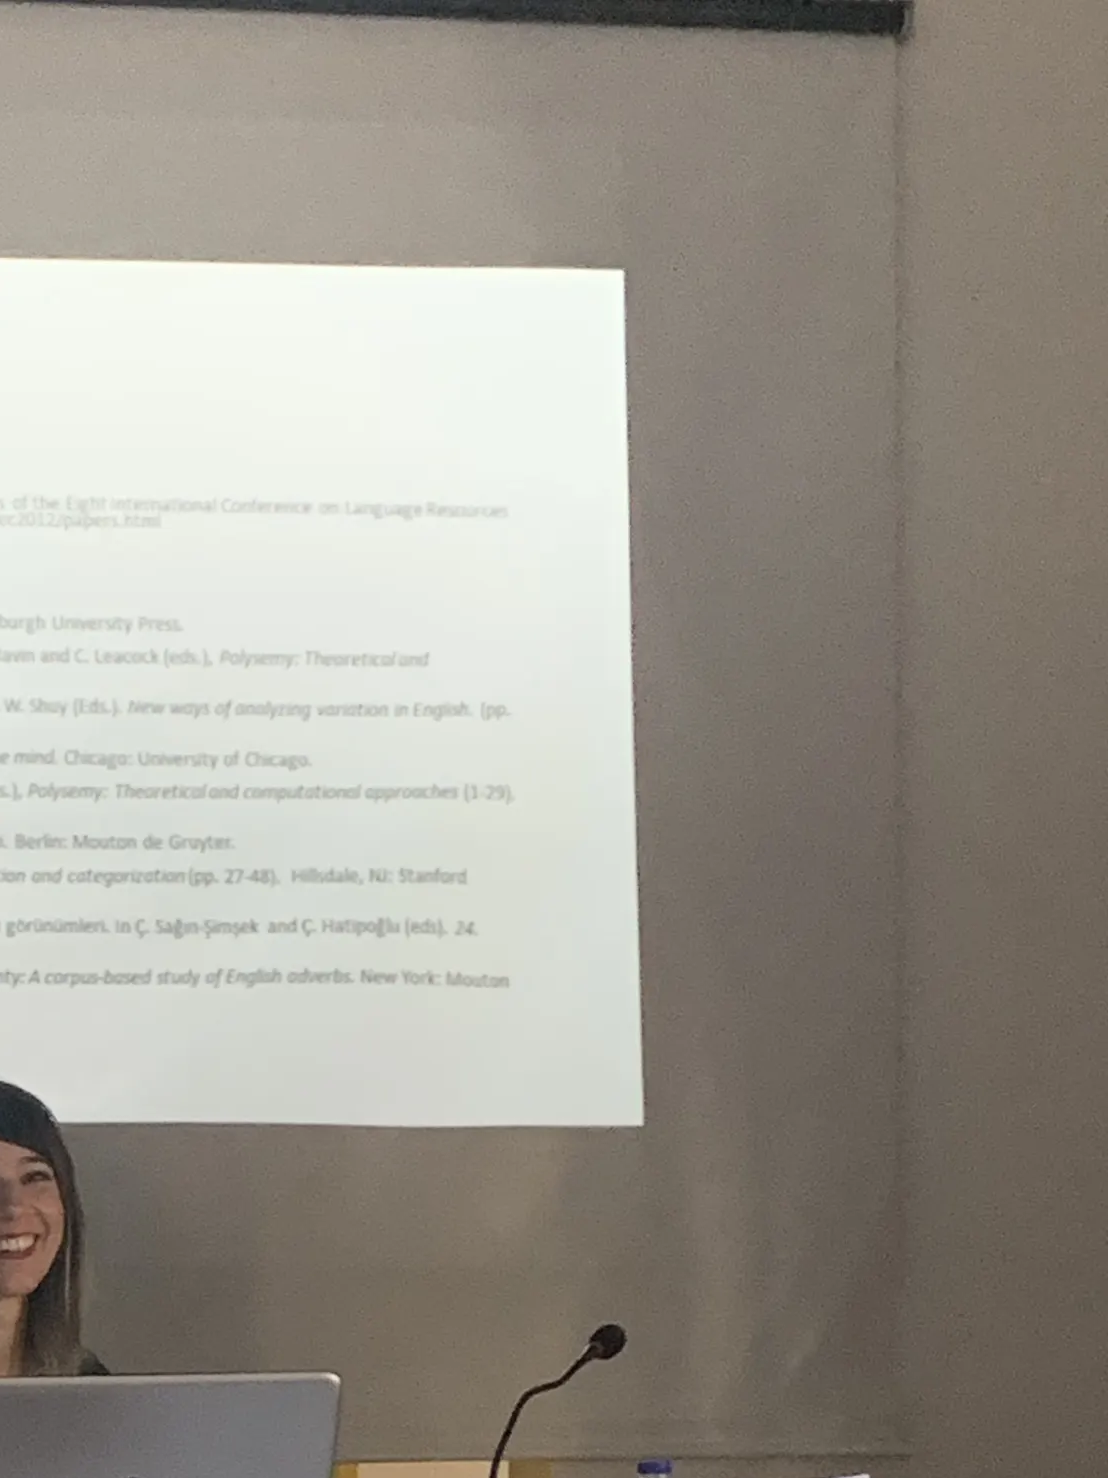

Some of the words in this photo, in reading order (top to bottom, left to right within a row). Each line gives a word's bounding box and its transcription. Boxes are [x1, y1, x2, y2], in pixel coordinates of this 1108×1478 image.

[137, 749, 219, 769] University
[115, 781, 207, 798] Theoretical
[242, 782, 362, 802] computational
[364, 783, 458, 803] approaches
[225, 970, 283, 989] English
